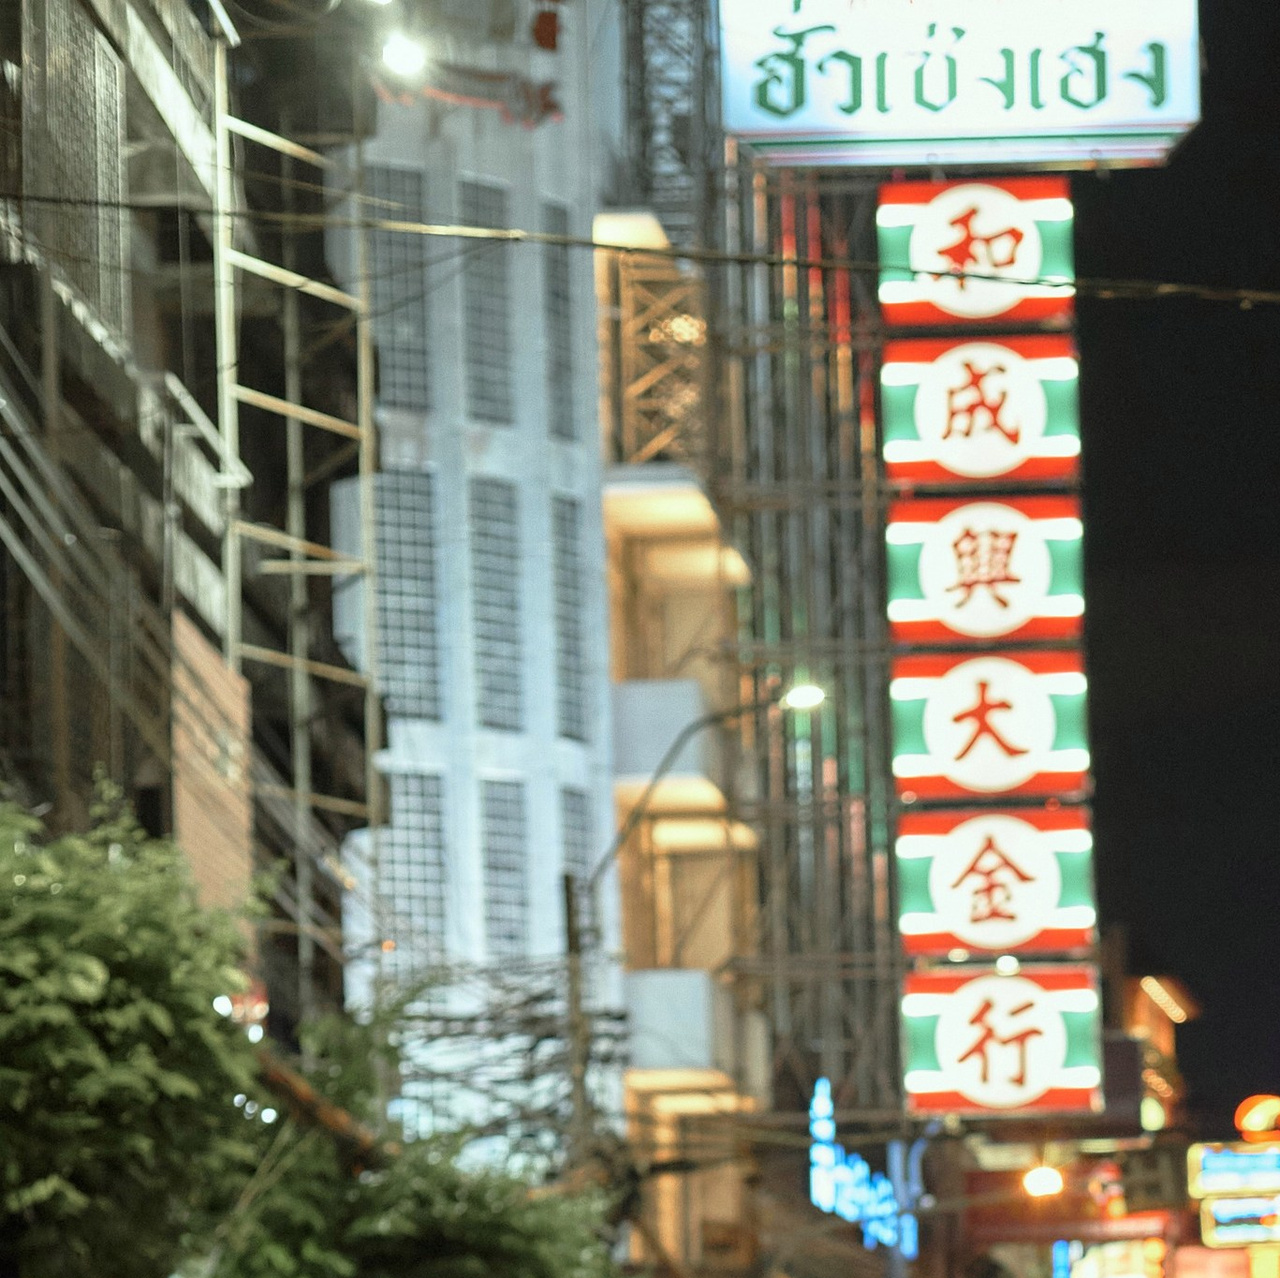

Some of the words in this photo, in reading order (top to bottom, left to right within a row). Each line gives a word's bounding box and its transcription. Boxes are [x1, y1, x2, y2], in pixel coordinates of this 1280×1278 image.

[931, 204, 1044, 1089] 和成興大金行
